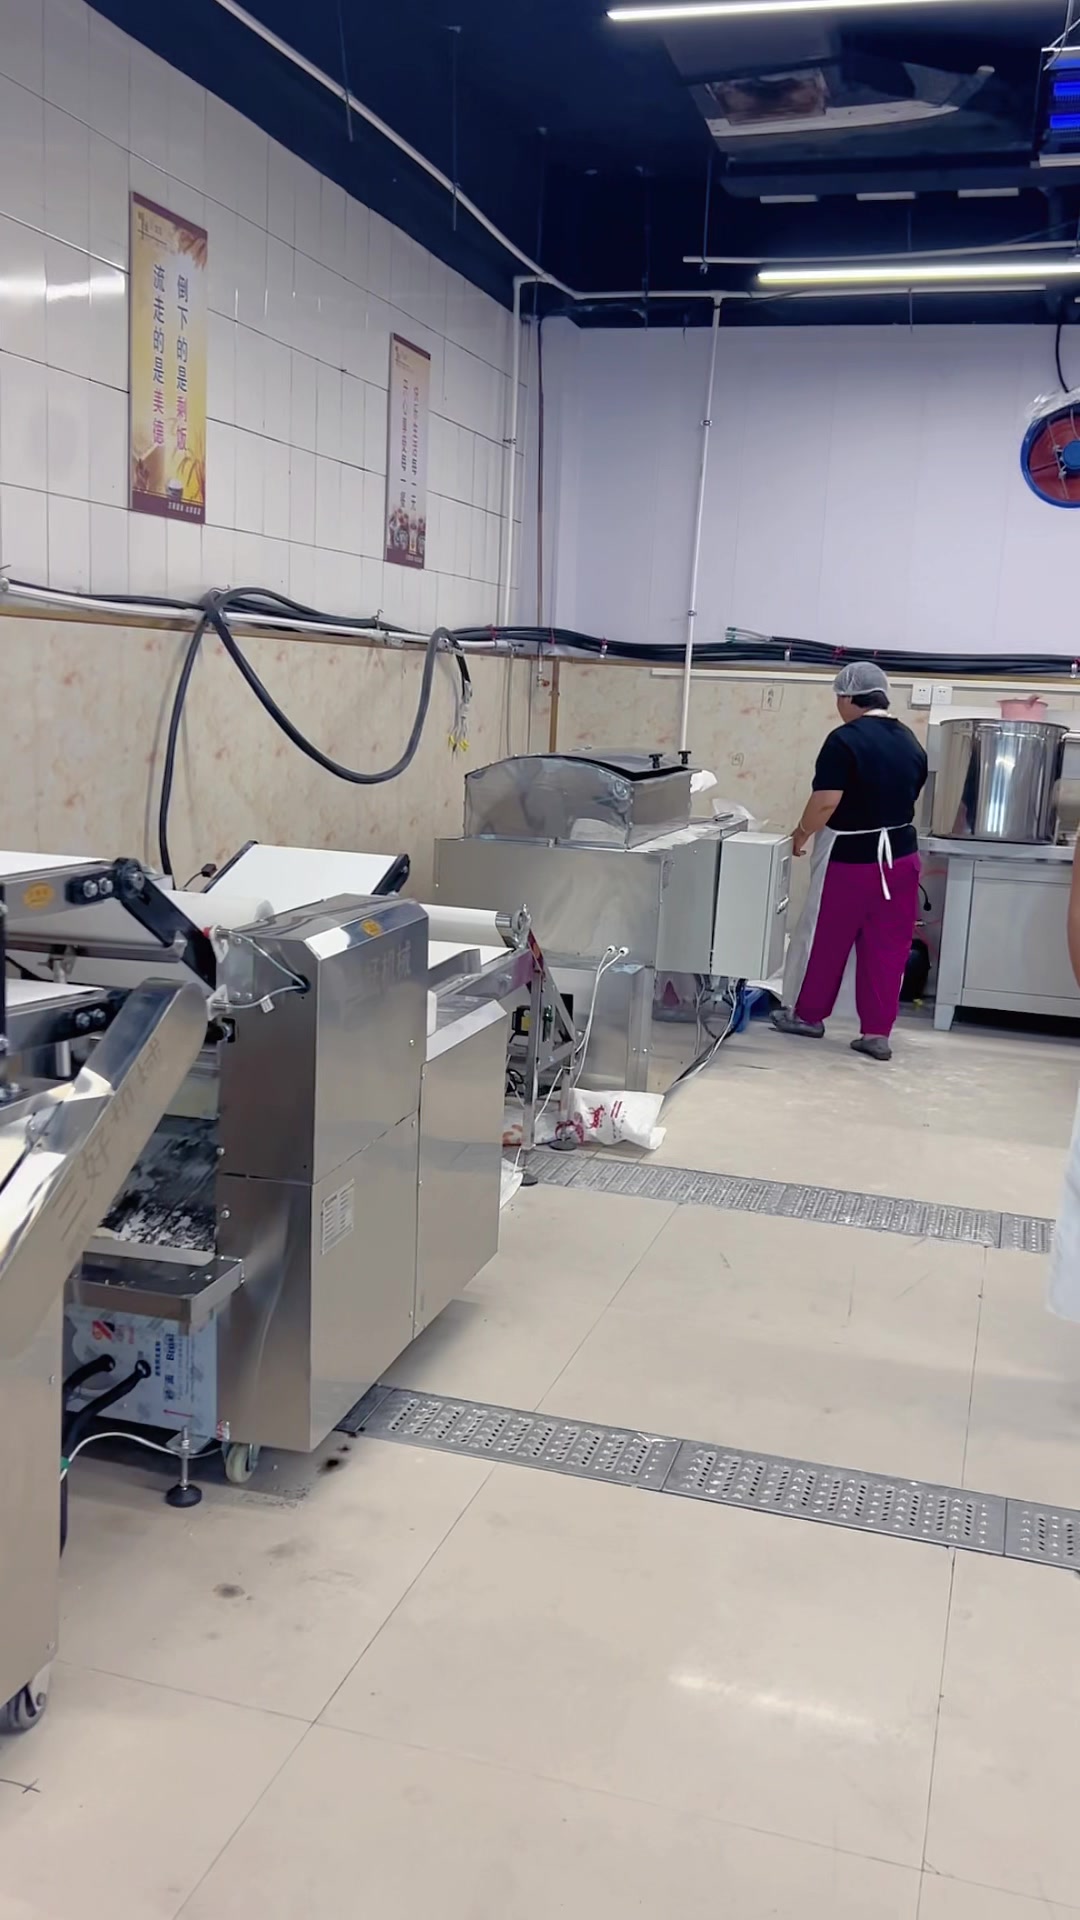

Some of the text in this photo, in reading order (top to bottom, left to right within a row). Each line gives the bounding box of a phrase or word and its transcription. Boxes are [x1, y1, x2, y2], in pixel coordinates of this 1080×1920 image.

[153, 264, 166, 447] 流走的是美德
[176, 274, 189, 451] 倒下的是剩饭
